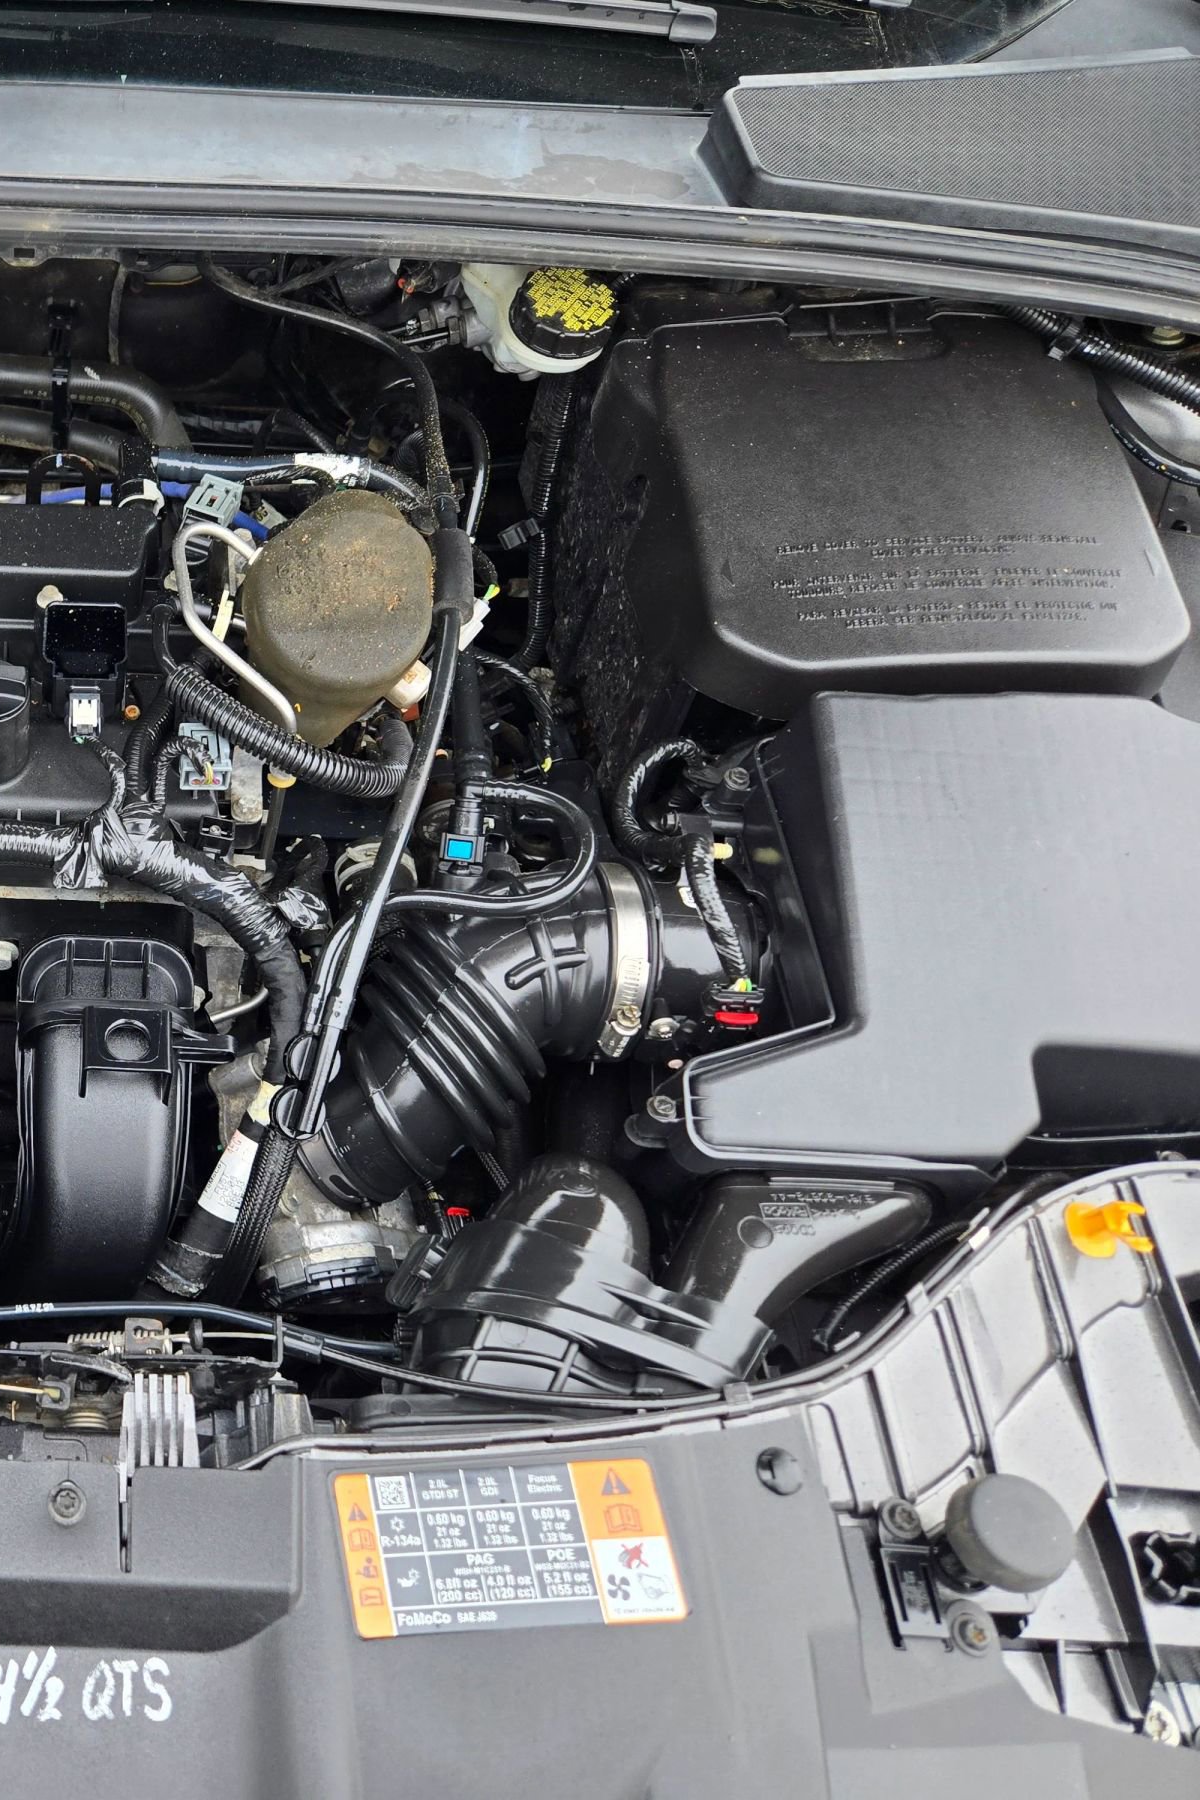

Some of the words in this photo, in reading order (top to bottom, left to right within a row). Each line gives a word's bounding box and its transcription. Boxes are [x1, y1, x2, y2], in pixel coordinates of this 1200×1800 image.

[528, 1474, 557, 1484] Focus
[527, 1482, 563, 1494] Electric
[450, 1513, 466, 1527] kg
[500, 1509, 516, 1524] kg
[556, 1507, 571, 1522] kg
[380, 1533, 422, 1548] R-134a
[466, 1552, 496, 1566] PAG
[546, 1547, 577, 1561] POE
[397, 1610, 452, 1627] FoMoCo
[82, 1656, 173, 1722] QTS
